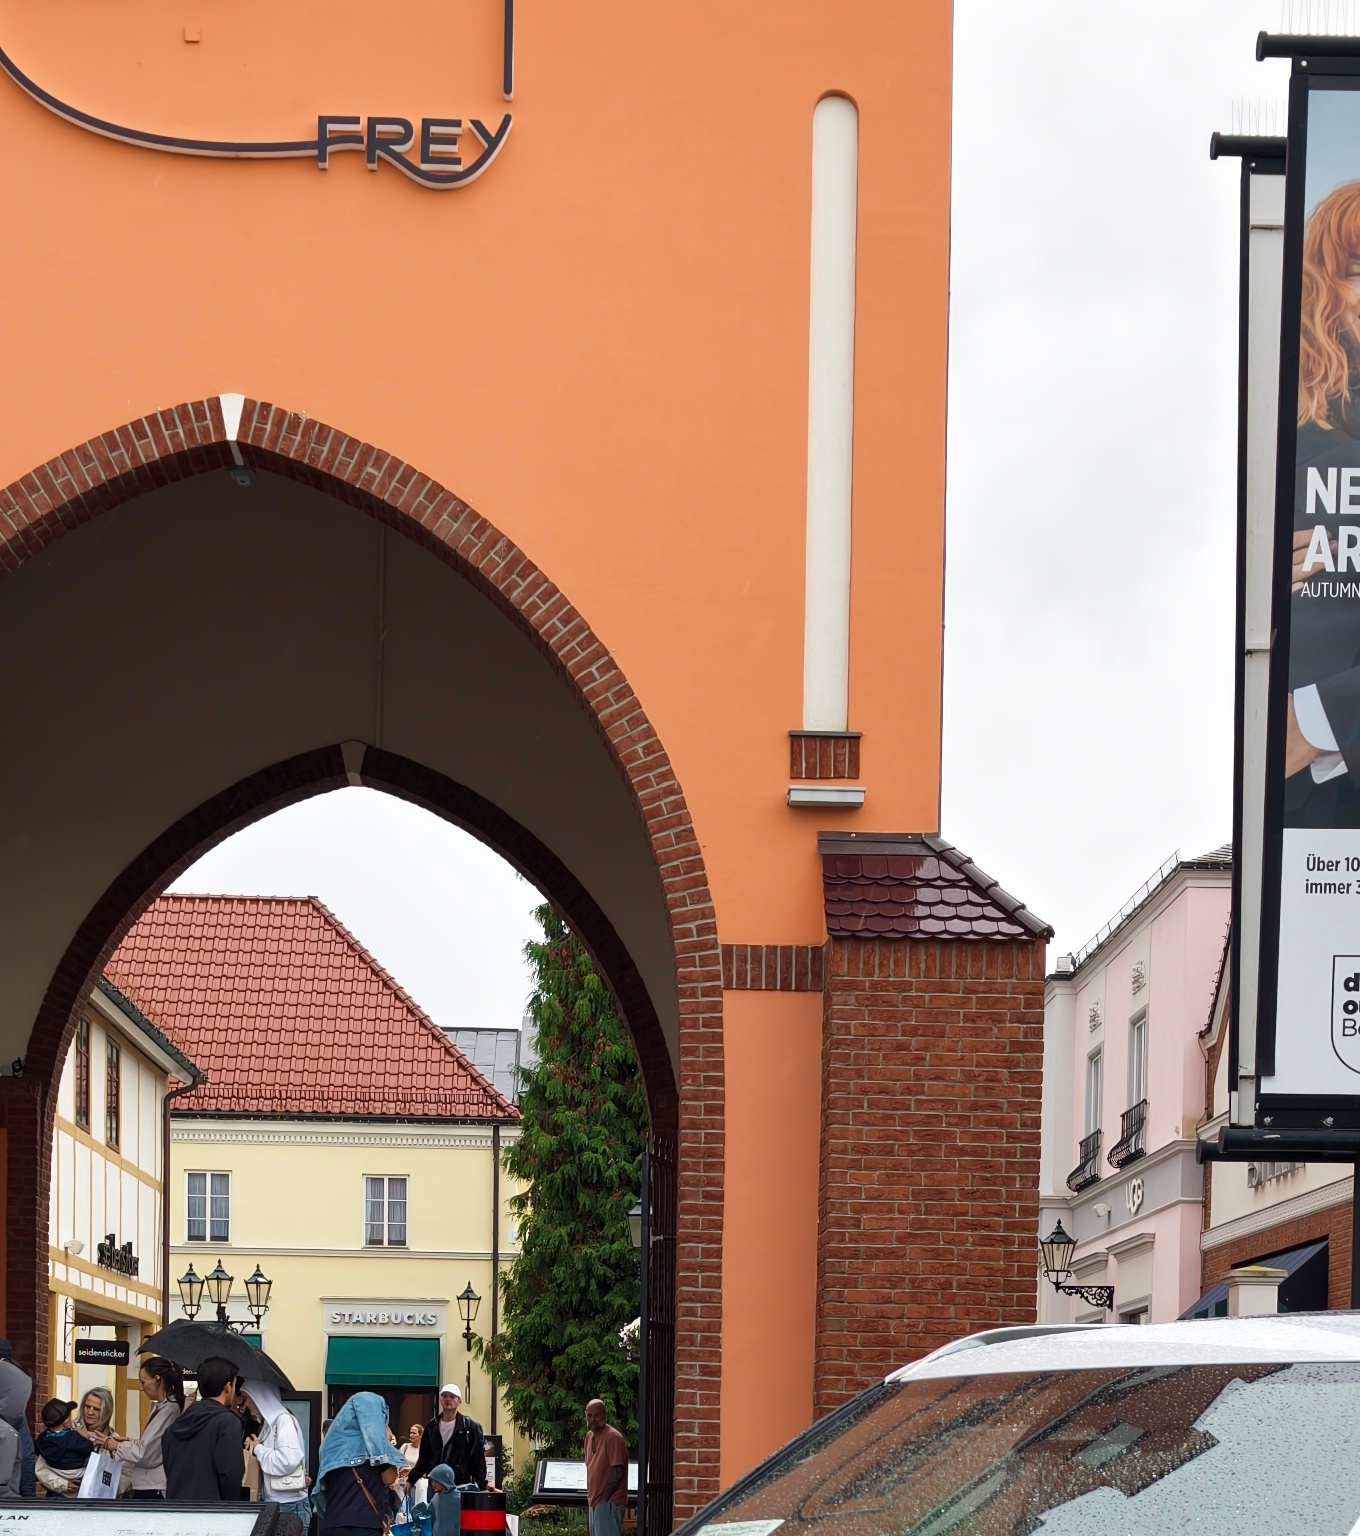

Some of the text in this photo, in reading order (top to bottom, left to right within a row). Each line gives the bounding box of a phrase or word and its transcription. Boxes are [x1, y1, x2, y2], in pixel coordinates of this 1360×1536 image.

[318, 114, 511, 189] FREY
[1306, 854, 1340, 872] Über
[1305, 880, 1352, 895] immer
[331, 1312, 437, 1325] STARBUCKS
[78, 1347, 125, 1358] seidensticker
